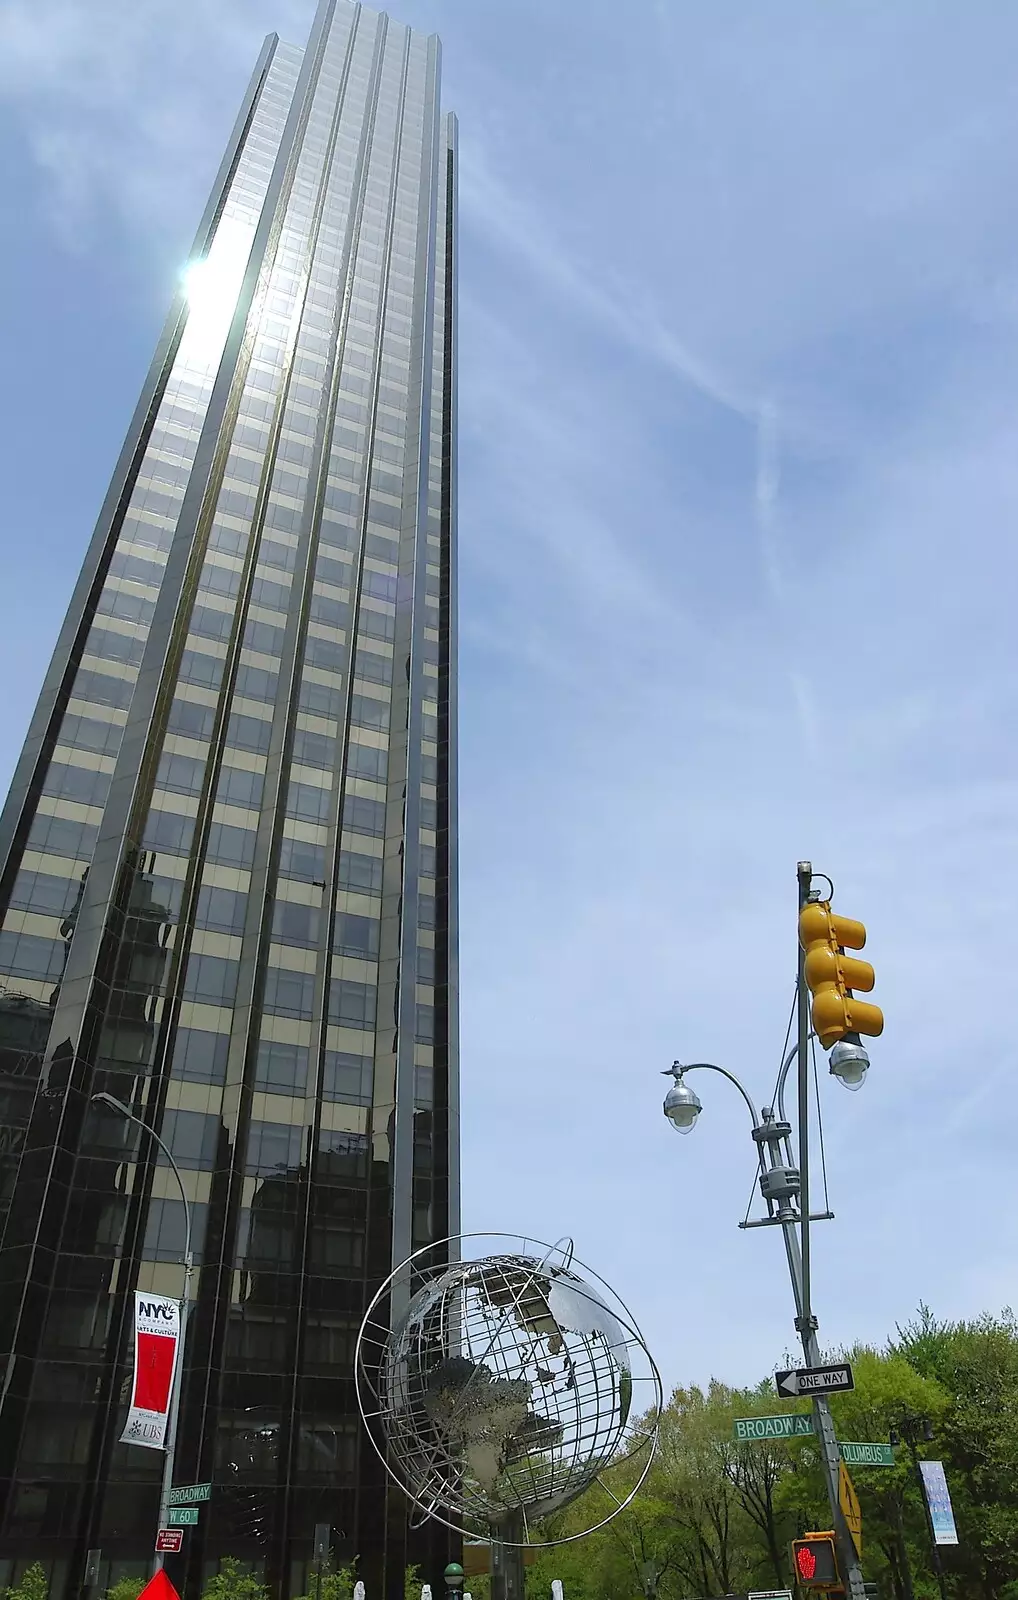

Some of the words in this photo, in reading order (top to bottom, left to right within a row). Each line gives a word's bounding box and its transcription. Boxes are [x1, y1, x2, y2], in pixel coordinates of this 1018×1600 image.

[139, 1301, 175, 1320] NYC
[154, 1328, 178, 1337] CULTURE
[799, 1376, 820, 1388] ONE
[823, 1372, 844, 1384] WAY
[142, 1424, 162, 1440] UBS
[736, 1416, 811, 1438] BROADWAY
[170, 1486, 210, 1503] BROADWAY
[170, 1511, 177, 1522] W
[179, 1511, 191, 1522] 60
